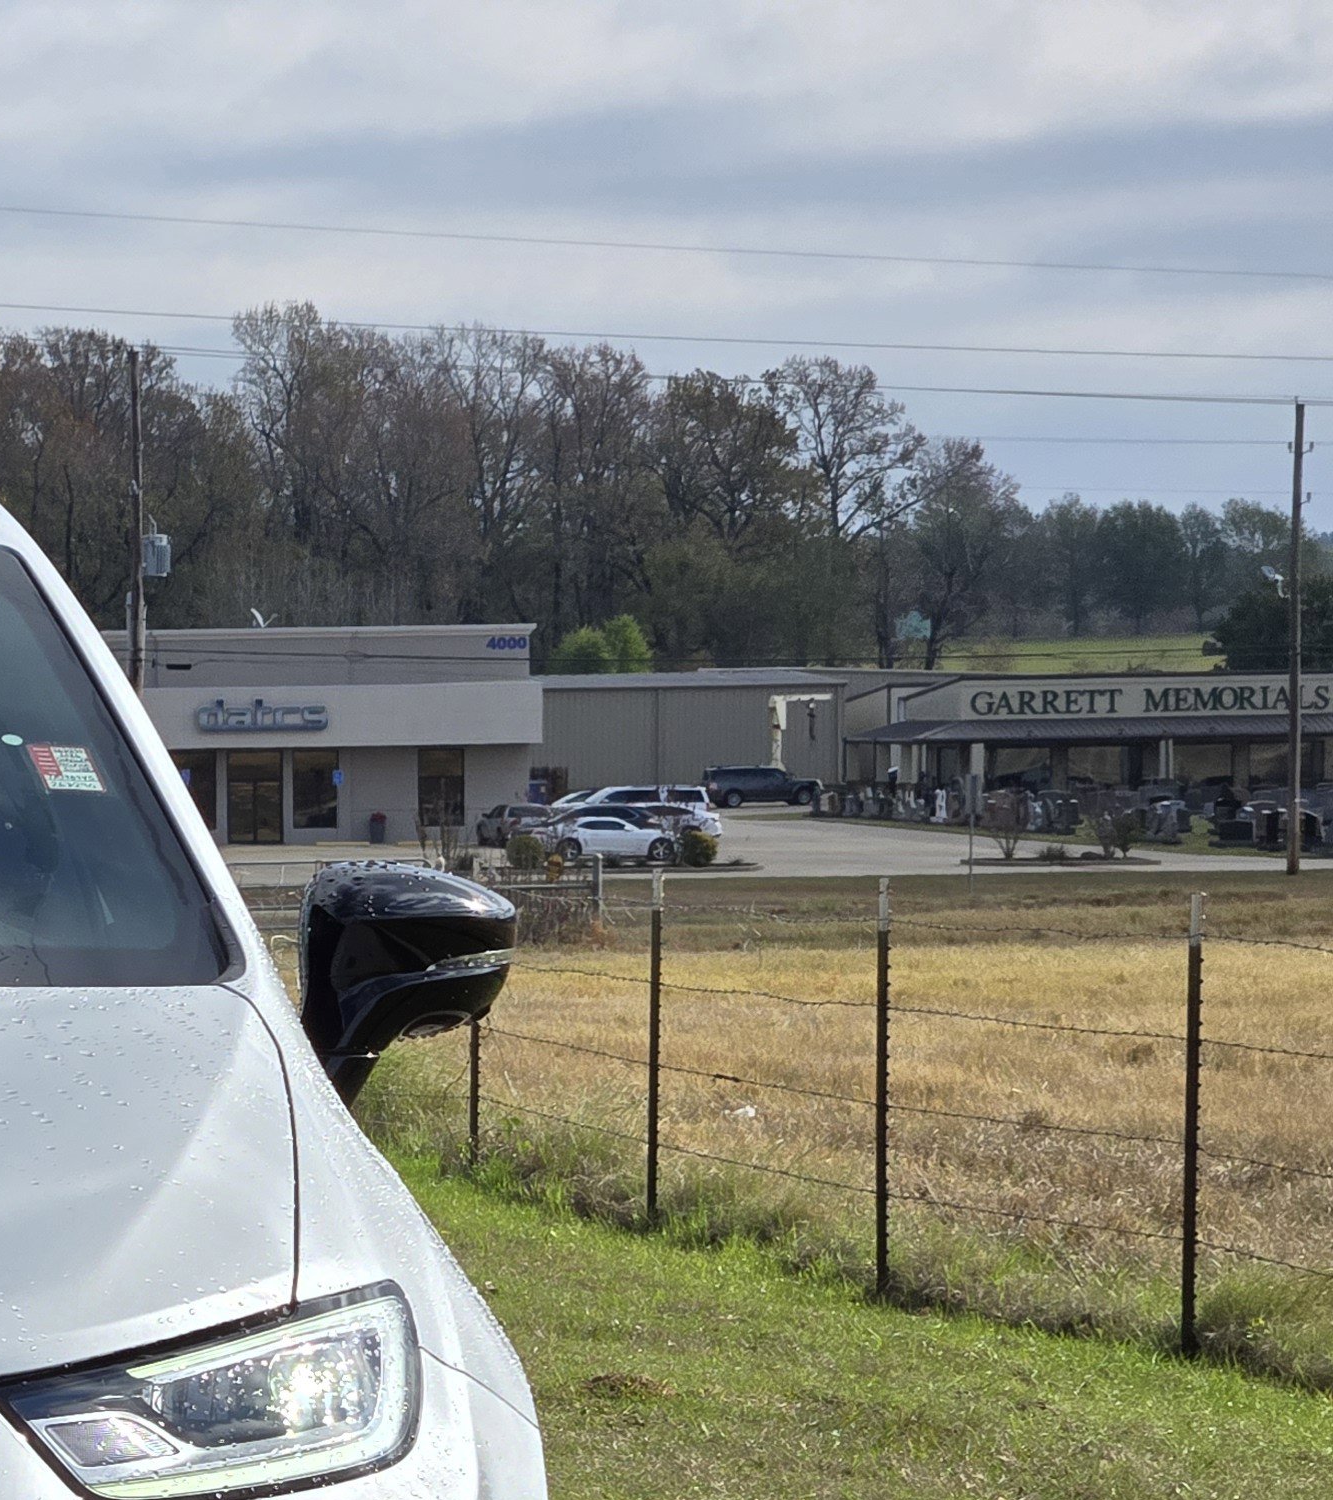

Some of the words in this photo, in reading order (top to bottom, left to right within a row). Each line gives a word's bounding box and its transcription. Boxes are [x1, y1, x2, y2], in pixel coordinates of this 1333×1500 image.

[486, 636, 527, 650] 4000
[970, 688, 1123, 716] GARRETT
[1143, 684, 1331, 712] MEMORIALS
